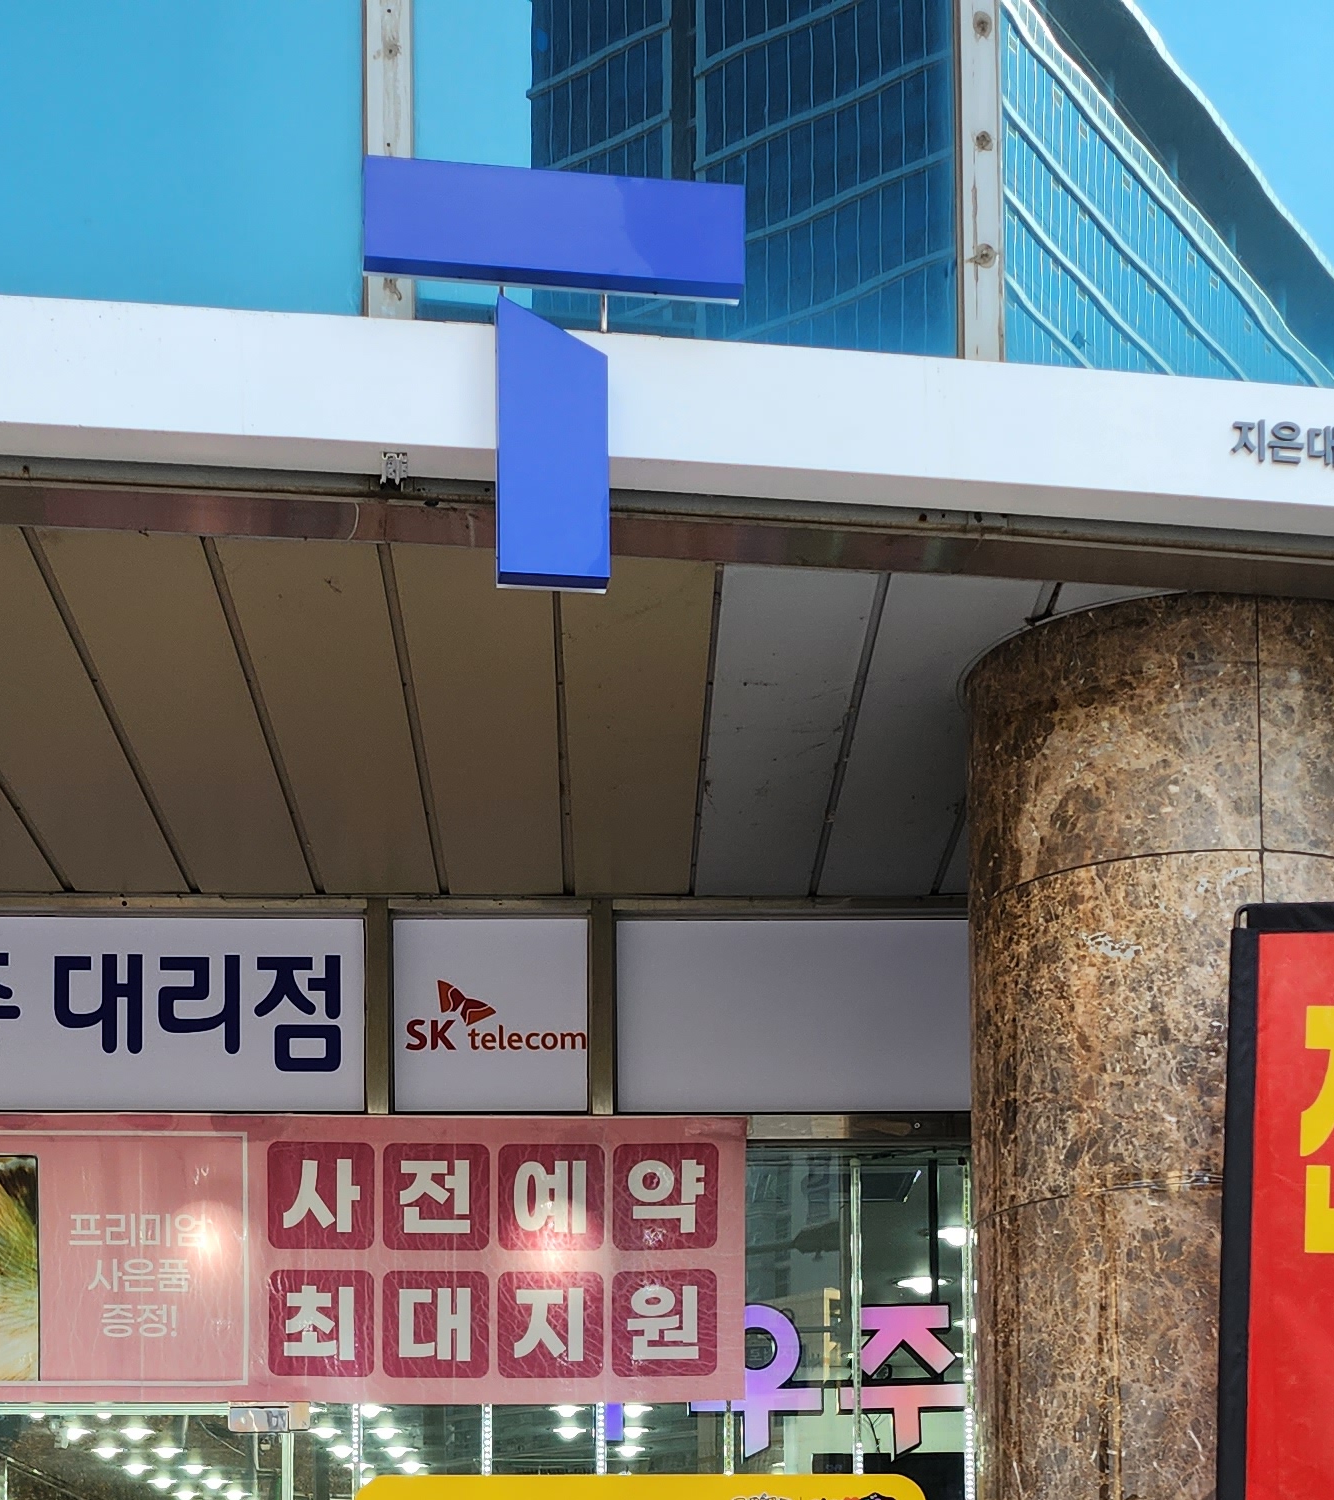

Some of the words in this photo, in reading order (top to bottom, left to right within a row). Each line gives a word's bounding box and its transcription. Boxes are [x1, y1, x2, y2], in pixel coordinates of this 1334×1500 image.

[53, 953, 343, 1073] 대리점
[405, 1019, 457, 1052] SK
[467, 1023, 588, 1053] telecom
[68, 1212, 209, 1249] 프리미엄
[88, 1258, 191, 1294] 사은품
[101, 1302, 179, 1338] 증정!
